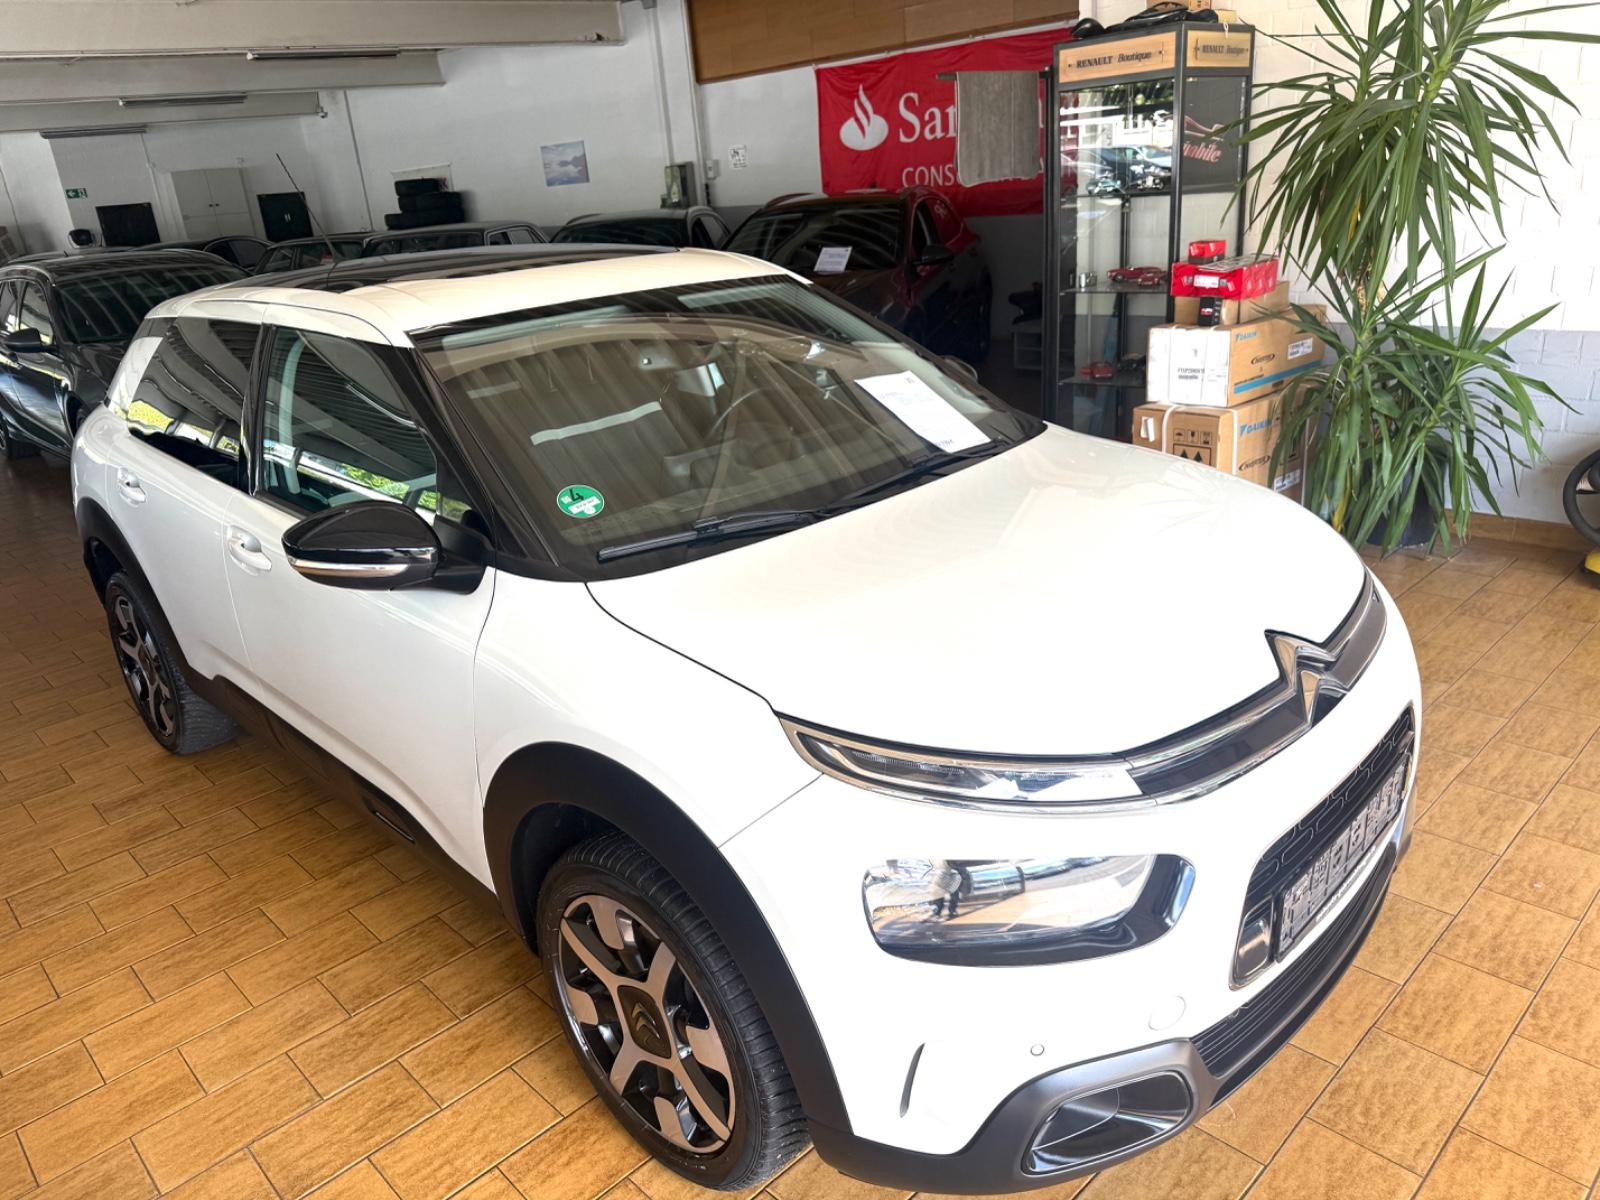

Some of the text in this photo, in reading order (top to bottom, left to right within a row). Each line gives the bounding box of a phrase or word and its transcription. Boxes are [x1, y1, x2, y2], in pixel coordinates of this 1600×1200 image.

[1076, 51, 1152, 68] RENAULT Boutique
[902, 164, 956, 187] CONS
